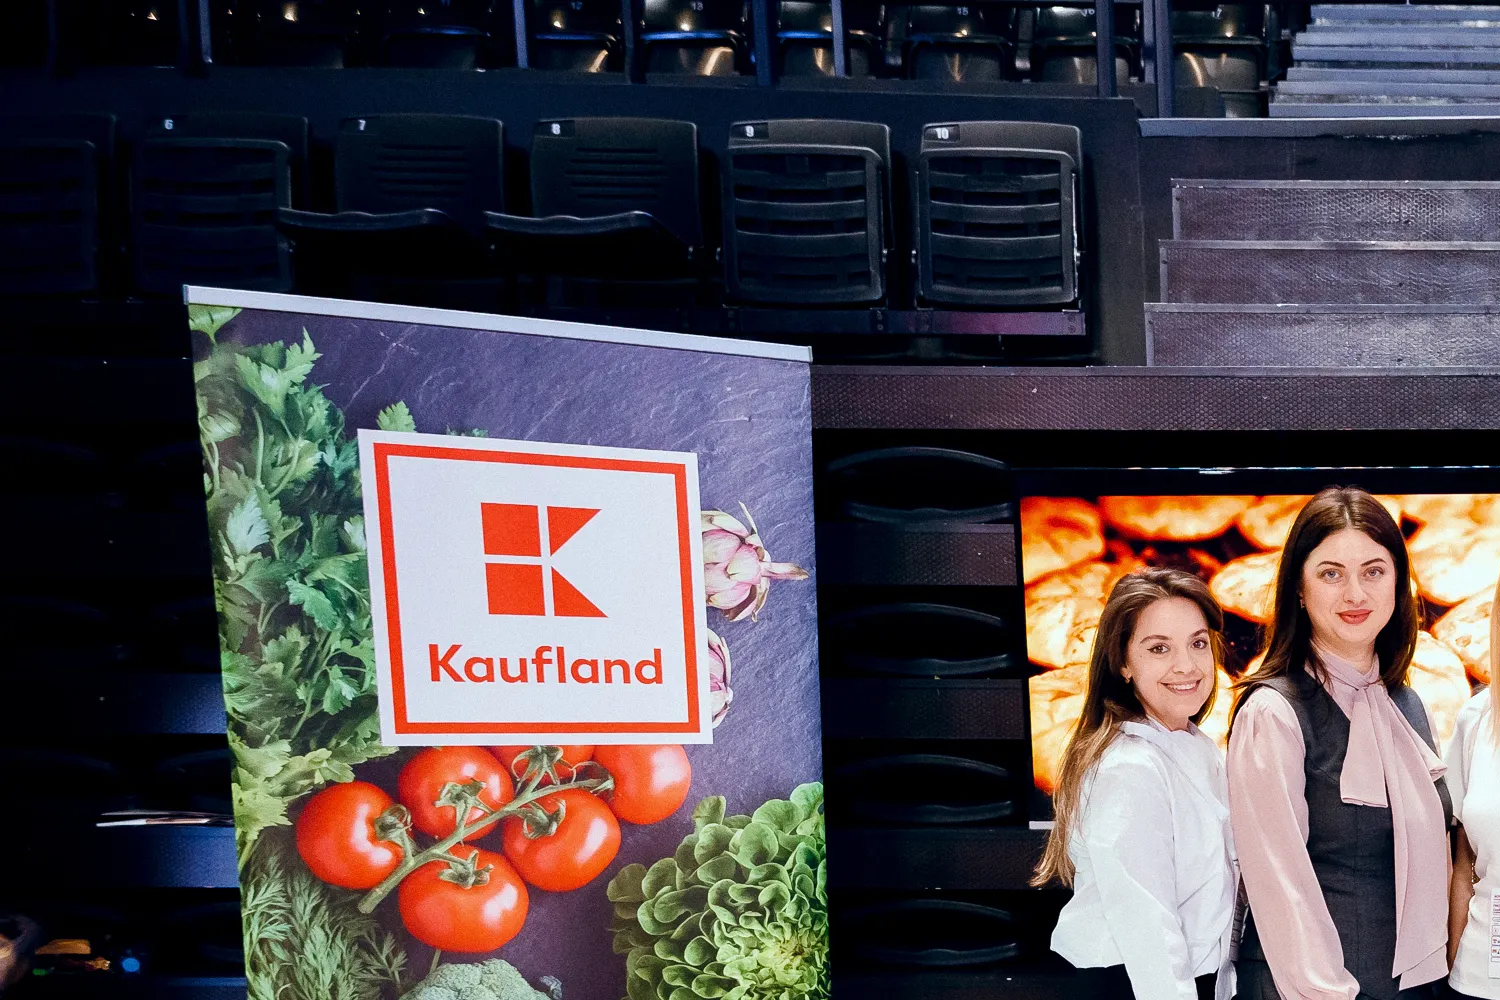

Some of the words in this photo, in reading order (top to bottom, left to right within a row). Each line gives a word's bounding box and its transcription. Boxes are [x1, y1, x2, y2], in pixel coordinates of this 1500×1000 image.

[165, 119, 173, 130] 6
[358, 119, 366, 130] 7
[552, 122, 561, 134] 8
[746, 126, 754, 137] 9
[935, 127, 949, 139] 10
[428, 643, 664, 685] Kaufland
